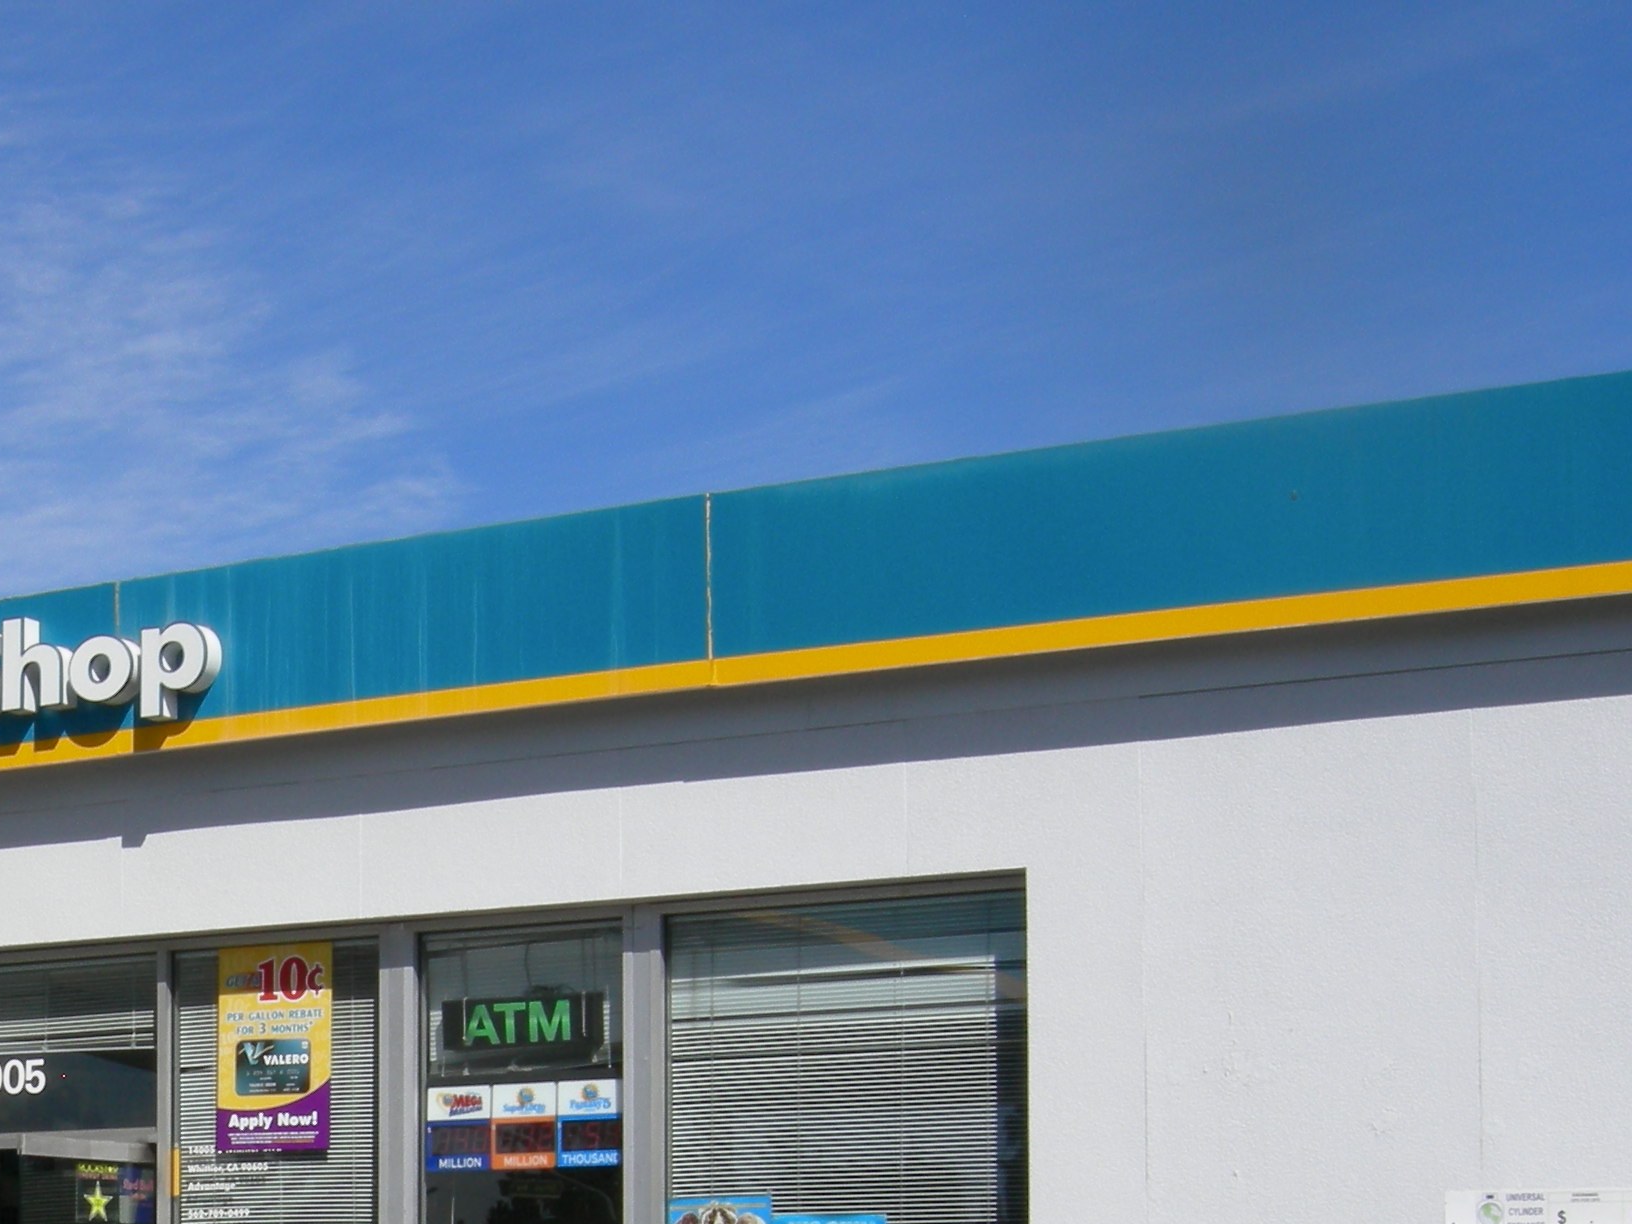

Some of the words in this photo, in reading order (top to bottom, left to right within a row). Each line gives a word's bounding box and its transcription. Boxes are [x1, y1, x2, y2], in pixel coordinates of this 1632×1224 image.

[227, 1012, 244, 1021] PER
[248, 1010, 284, 1021] GALLON
[288, 1008, 323, 1019] REBATE
[236, 1025, 254, 1035] FOR
[259, 1022, 266, 1034] 3
[468, 1000, 572, 1046] ATM
[263, 1053, 309, 1066] VALERO
[228, 1111, 272, 1131] Apply
[277, 1110, 318, 1126] Now!
[438, 1157, 482, 1169] MILLION
[504, 1155, 548, 1167] MILLION
[1506, 1193, 1545, 1201] UNIVERSAL
[1508, 1207, 1543, 1216] CYLINDER
